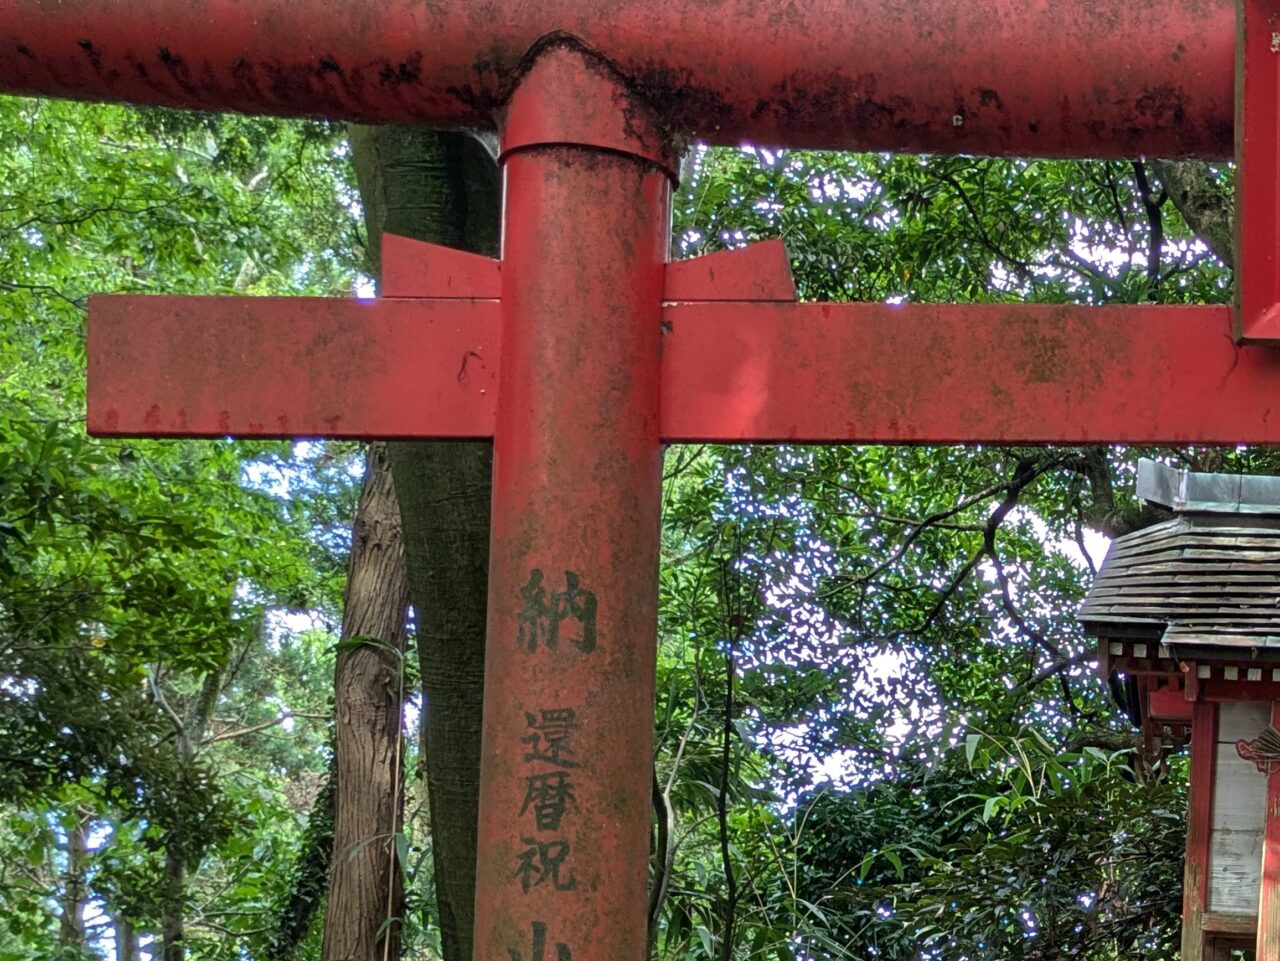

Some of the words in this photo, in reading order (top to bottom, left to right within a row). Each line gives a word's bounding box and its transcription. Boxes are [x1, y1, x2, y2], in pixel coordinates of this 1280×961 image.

[516, 570, 597, 653] 納
[515, 707, 579, 893] 還暦祝
